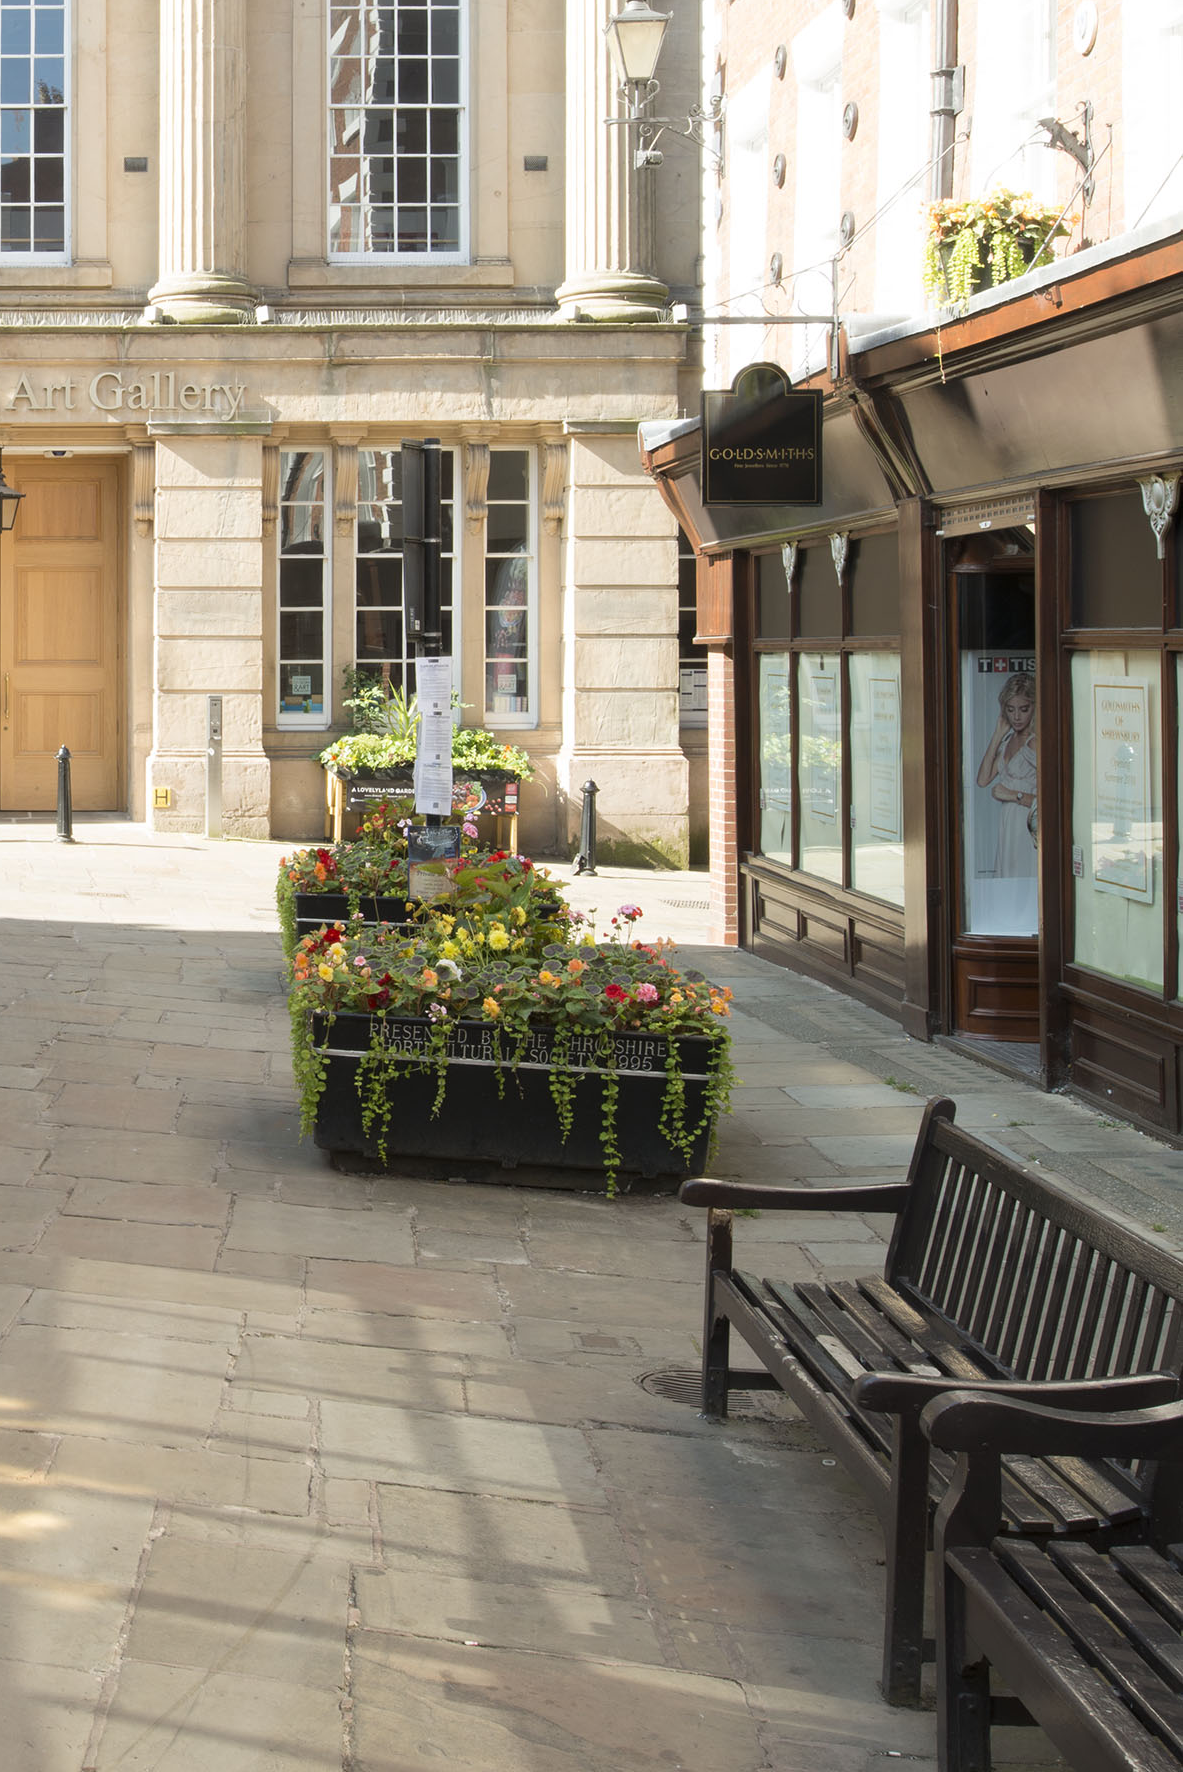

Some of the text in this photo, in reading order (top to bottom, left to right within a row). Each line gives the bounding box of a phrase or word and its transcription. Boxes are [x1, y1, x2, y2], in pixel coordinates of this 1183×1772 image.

[4, 371, 77, 411] Art
[88, 371, 248, 422] Gallery
[154, 788, 169, 805] H
[369, 1022, 468, 1044] PRESENED
